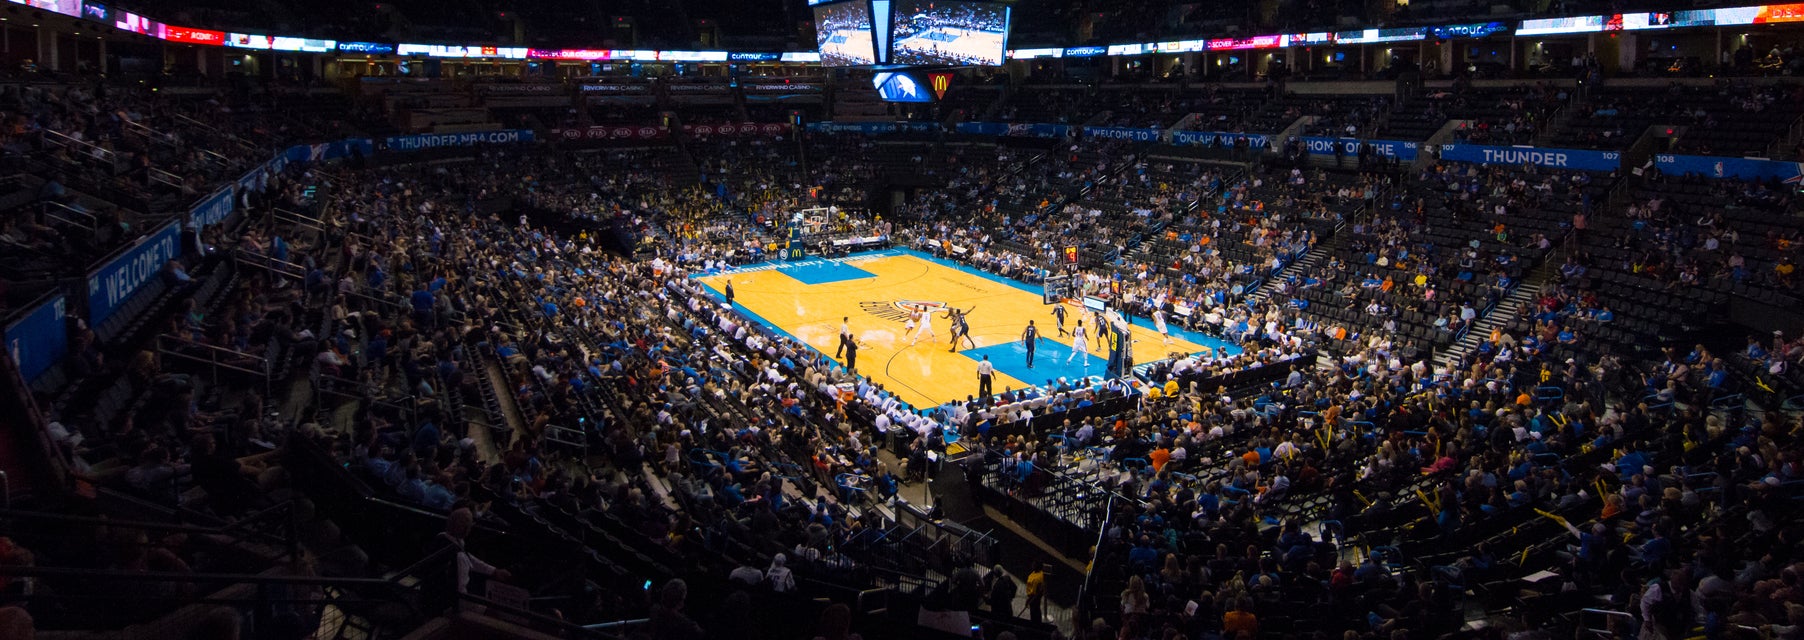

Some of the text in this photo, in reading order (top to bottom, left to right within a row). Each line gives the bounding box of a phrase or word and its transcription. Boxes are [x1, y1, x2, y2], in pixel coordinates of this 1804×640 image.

[1092, 128, 1148, 140] WELCOME TO
[1483, 149, 1567, 167] THUNDER
[1656, 155, 1675, 163] 108
[105, 244, 160, 308] WELCOME
[161, 234, 174, 264] TO
